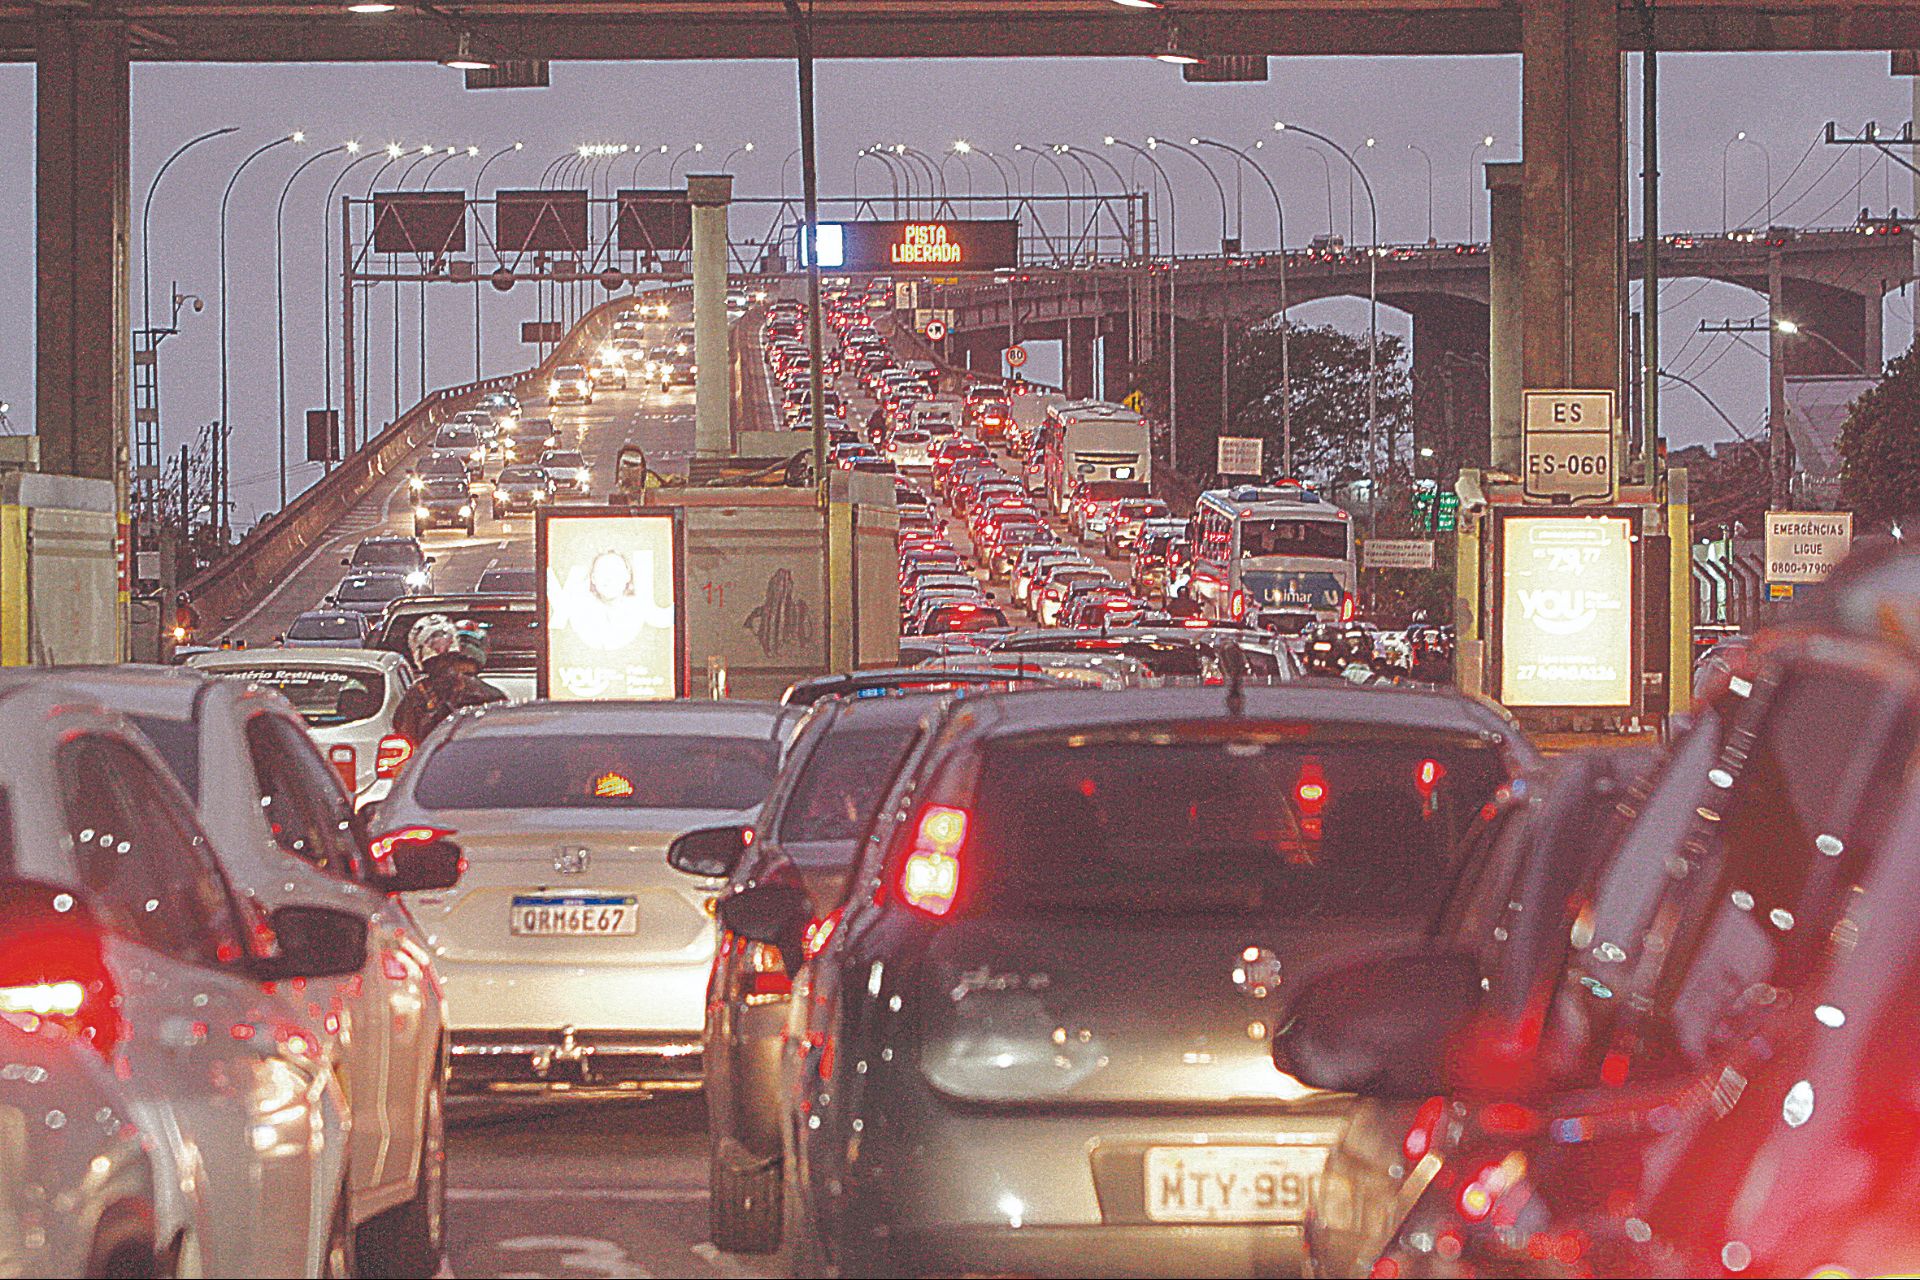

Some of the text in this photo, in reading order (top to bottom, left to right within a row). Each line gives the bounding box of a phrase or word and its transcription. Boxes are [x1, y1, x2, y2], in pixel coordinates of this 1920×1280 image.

[905, 224, 947, 245] PISTA
[891, 243, 961, 263] LIBERADA
[1009, 350, 1023, 360] 80
[1554, 403, 1581, 422] ES
[1529, 455, 1606, 475] ES-060
[1773, 521, 1844, 536] EMERGÊNCIAS
[1794, 544, 1822, 555] LIGUE
[1517, 589, 1585, 619] YOU
